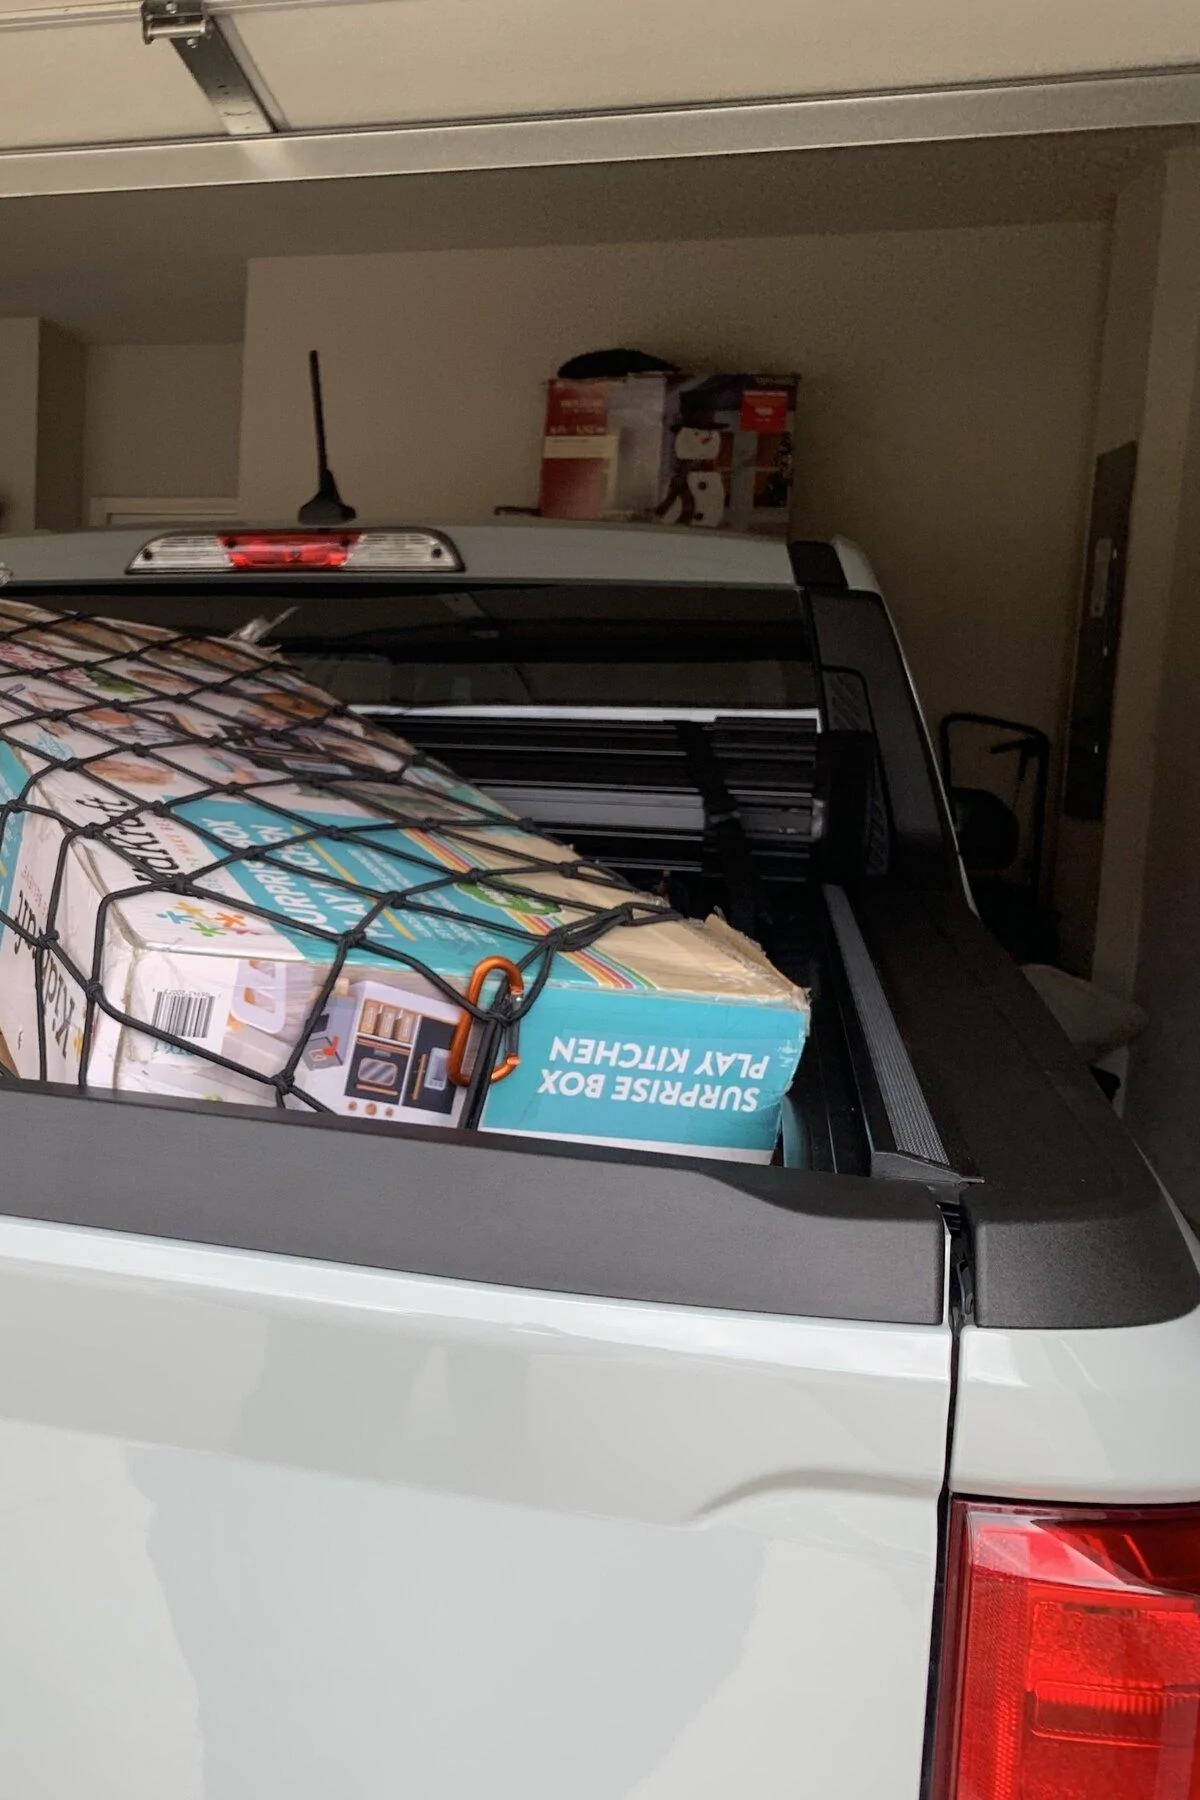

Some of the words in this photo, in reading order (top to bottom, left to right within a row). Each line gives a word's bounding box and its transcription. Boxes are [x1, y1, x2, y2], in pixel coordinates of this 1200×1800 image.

[548, 1035, 691, 1074] KITCHEN
[693, 1050, 771, 1080] PLAY
[536, 1068, 607, 1100] BOX
[610, 1075, 761, 1113] SURPRISE
